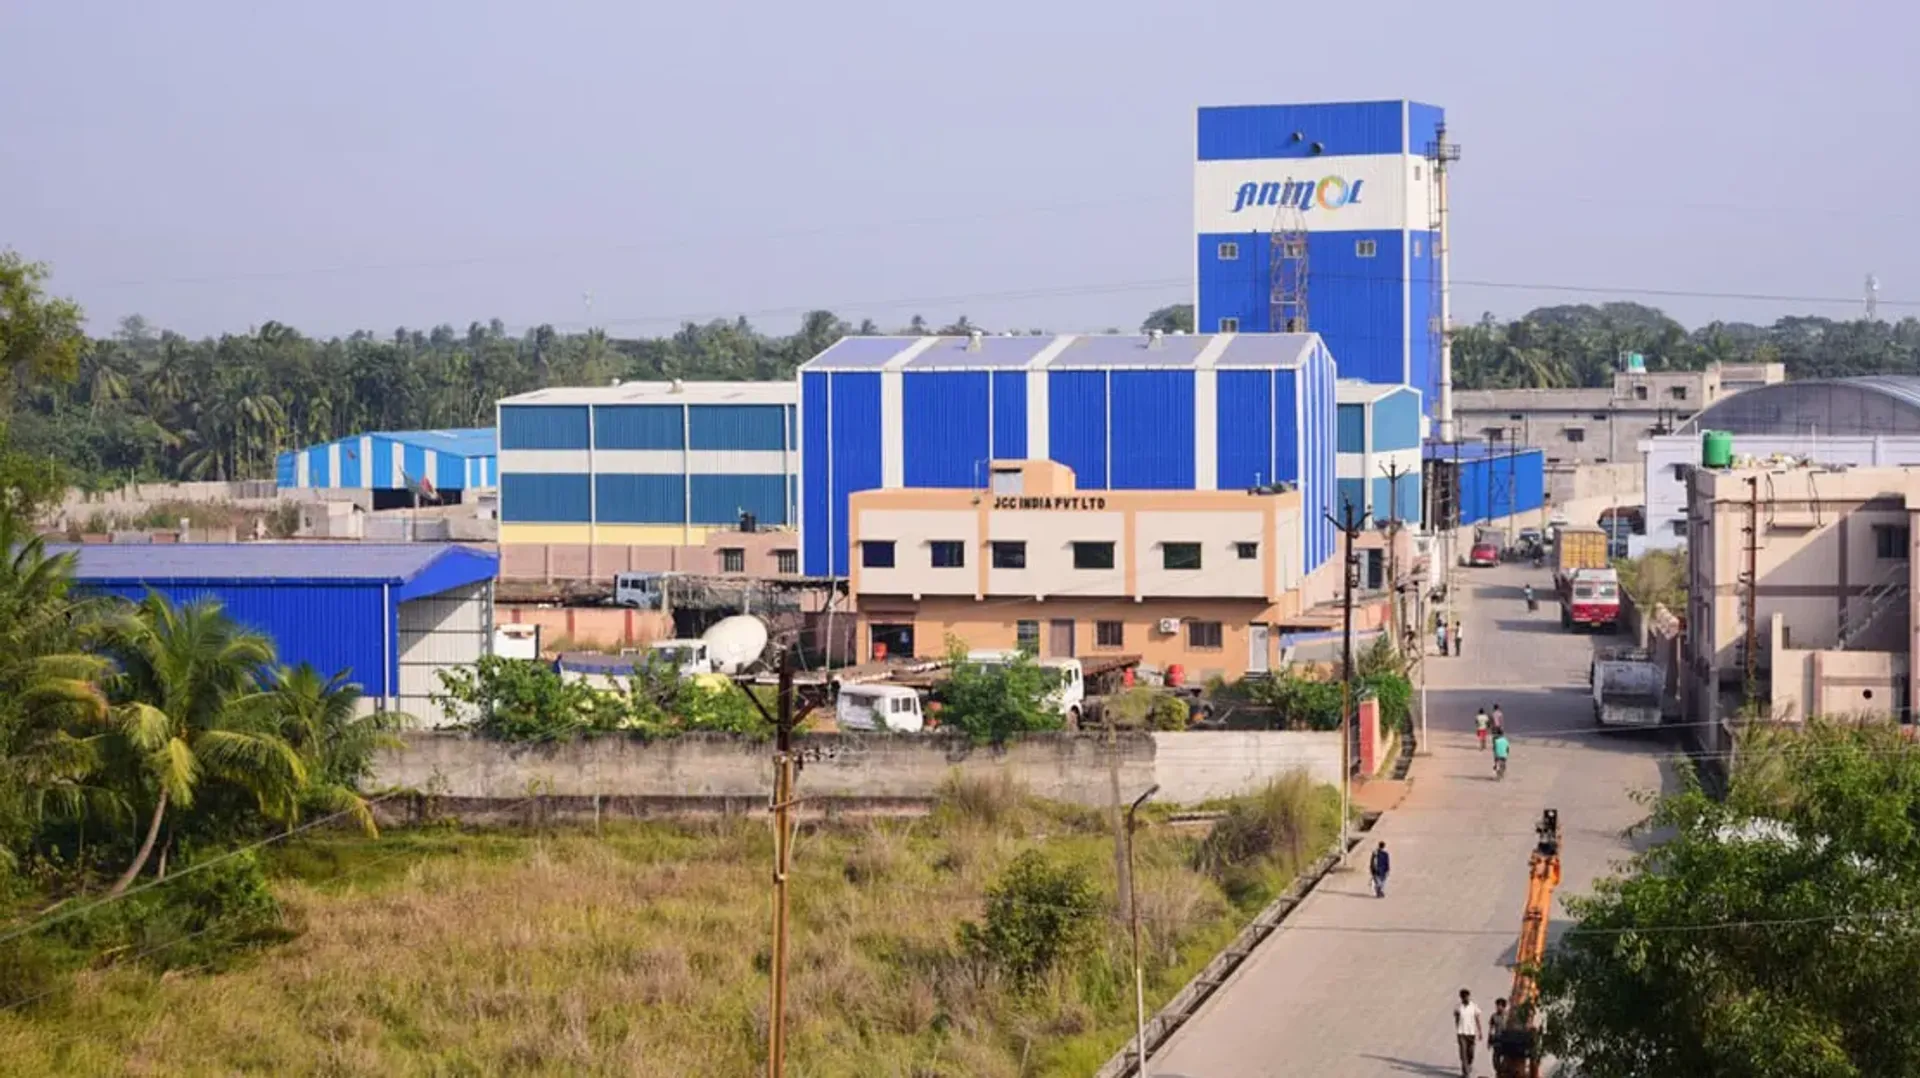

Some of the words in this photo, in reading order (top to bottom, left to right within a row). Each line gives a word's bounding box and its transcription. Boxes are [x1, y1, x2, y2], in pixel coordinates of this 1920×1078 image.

[994, 497, 1017, 510] JCC
[1019, 497, 1052, 510] INDIA
[1055, 497, 1079, 510] PVT
[1082, 497, 1106, 510] LTD
